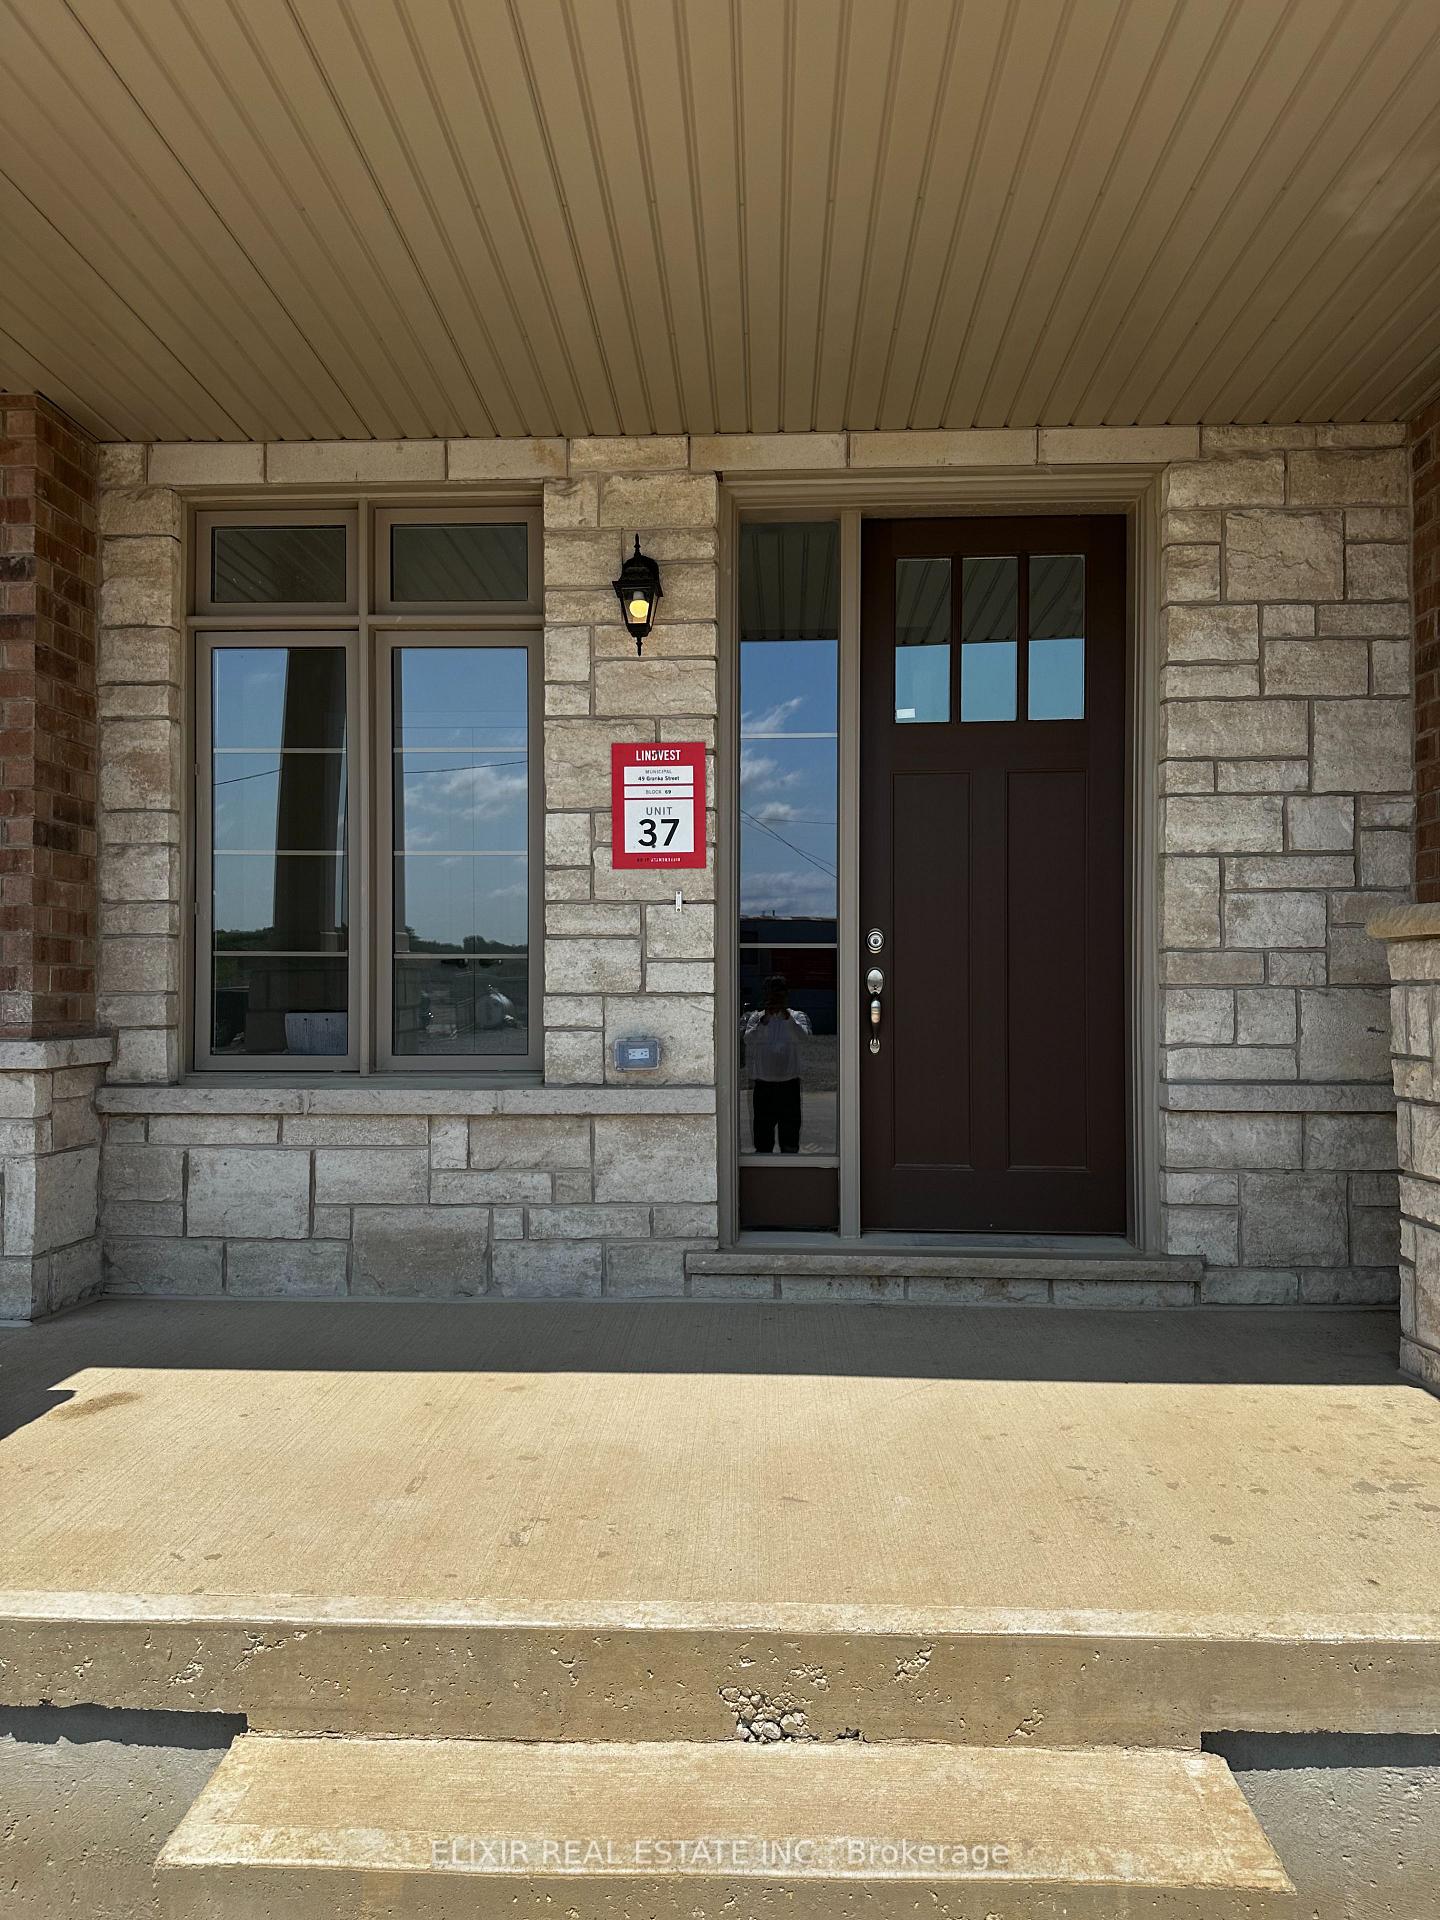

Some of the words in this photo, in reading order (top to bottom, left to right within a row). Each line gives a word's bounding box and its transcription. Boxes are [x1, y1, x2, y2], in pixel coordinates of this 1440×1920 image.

[636, 749, 681, 761] LINDVEST
[646, 807, 672, 815] UNIT
[638, 818, 680, 847] 37
